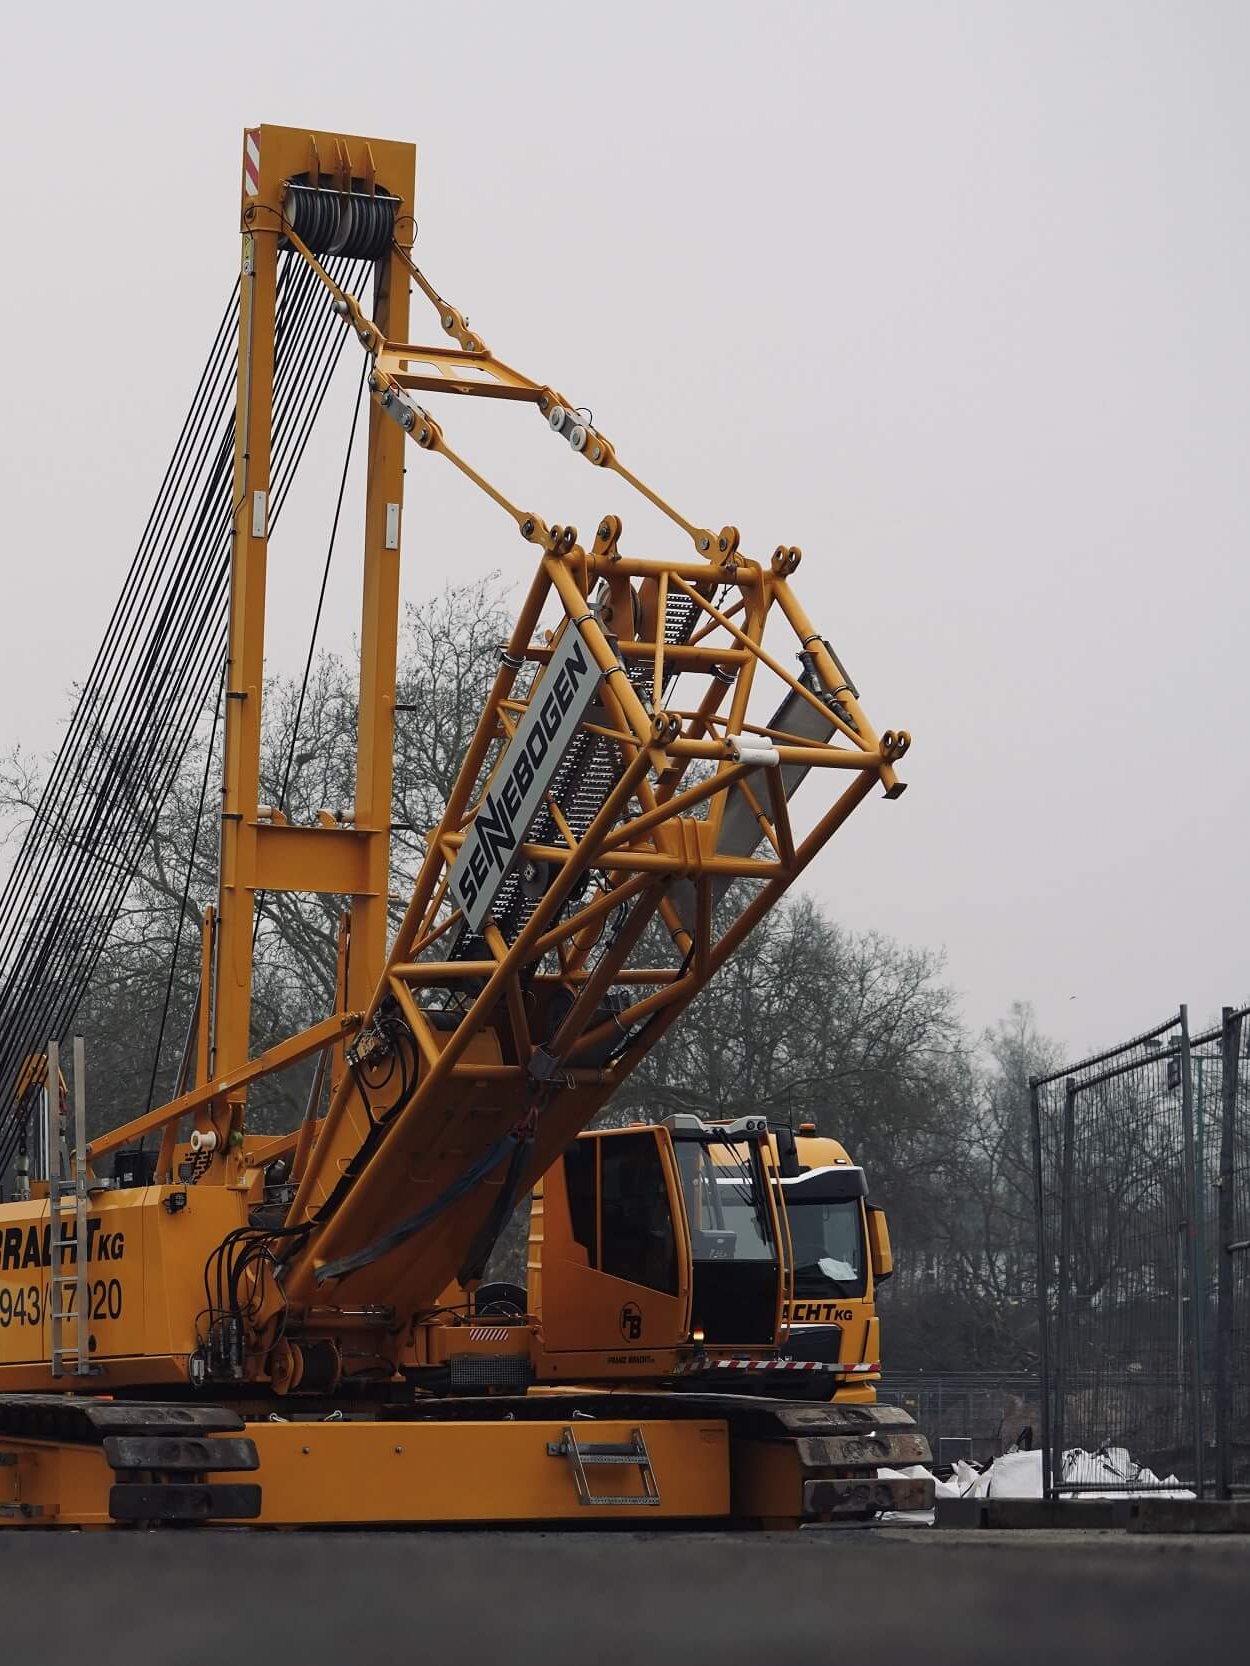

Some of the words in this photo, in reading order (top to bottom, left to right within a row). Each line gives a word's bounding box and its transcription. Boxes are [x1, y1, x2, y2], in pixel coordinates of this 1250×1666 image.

[458, 640, 588, 912] SENNEBOGEN
[97, 1232, 124, 1261] KG
[834, 1309, 853, 1321] KG
